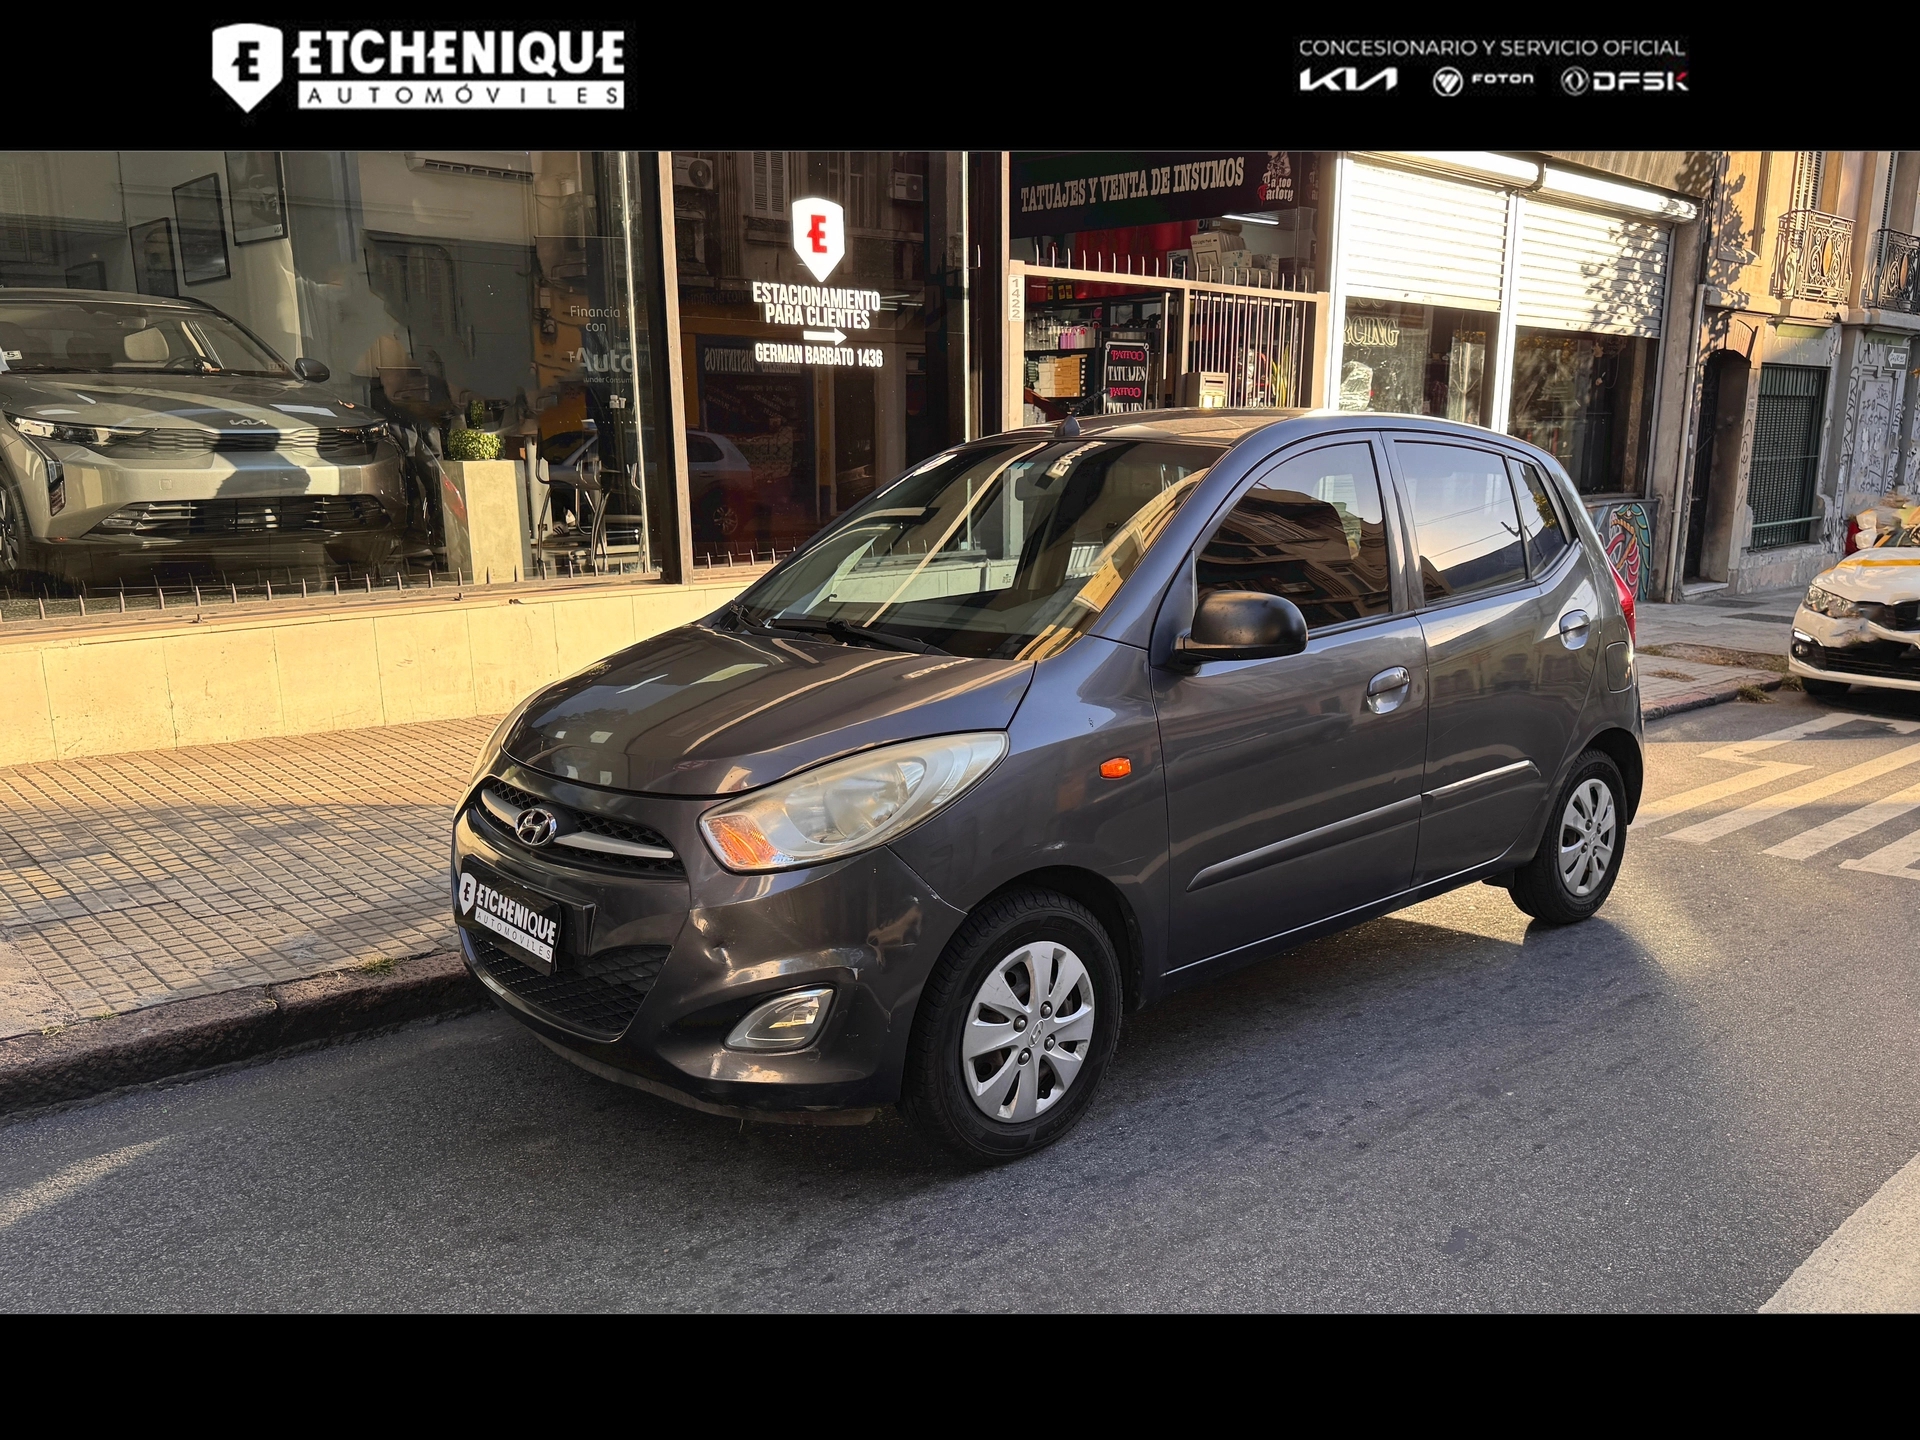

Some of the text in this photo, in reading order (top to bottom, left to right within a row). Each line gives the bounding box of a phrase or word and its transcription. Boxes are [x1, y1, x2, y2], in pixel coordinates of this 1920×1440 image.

[1021, 156, 1245, 212] TATUAJES Y VENTA DE INSUMOS
[752, 281, 881, 312] ESTACIONAMIENTO
[1011, 278, 1021, 319] 1422
[570, 305, 620, 318] Financia
[765, 303, 871, 330] PARA CLIENTES
[585, 323, 607, 332] con
[755, 342, 884, 368] GERMAN BARBATO 1436
[1110, 350, 1146, 361] TATTOO
[1107, 366, 1146, 382] TATUAJES
[1109, 387, 1142, 399] TATTOO
[476, 883, 557, 945] ETCHENIQUE
